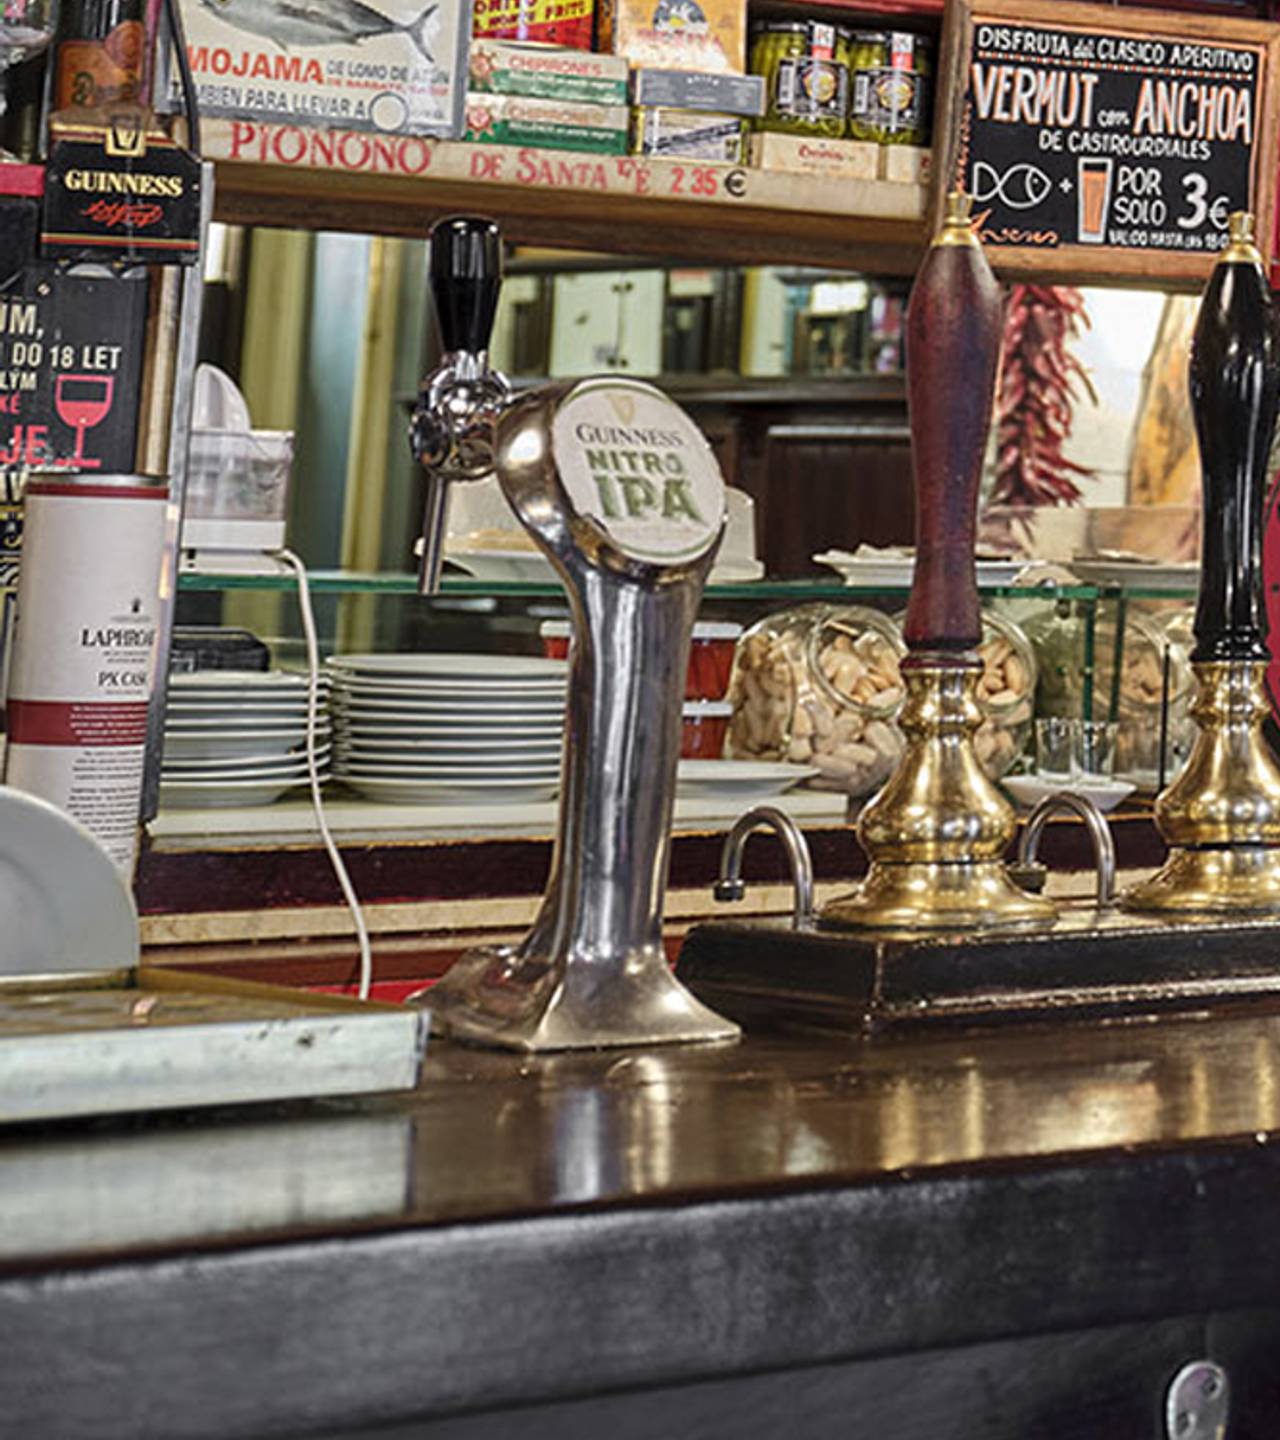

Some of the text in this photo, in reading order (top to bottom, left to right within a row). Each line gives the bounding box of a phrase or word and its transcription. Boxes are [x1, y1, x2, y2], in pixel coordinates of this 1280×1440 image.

[977, 26, 1071, 59] DISFRUTA
[1097, 39, 1166, 66] CLASICO
[1170, 47, 1254, 72] APERITIVO
[349, 61, 388, 80] LOMO
[246, 87, 287, 109] PARA
[292, 92, 345, 115] LLEVAR
[971, 63, 1252, 145] VERMUT con ANCHOA
[229, 119, 434, 176] PIONONO
[469, 151, 502, 180] DE
[1039, 131, 1063, 153] DE
[64, 169, 183, 198] GUINNESS
[1118, 165, 1162, 196] POR
[1113, 196, 1167, 226] SOLO
[12, 341, 122, 370] DO 18 LET
[575, 422, 685, 447] GUINNESS
[584, 449, 685, 475] NITRO
[592, 474, 711, 528] IPA
